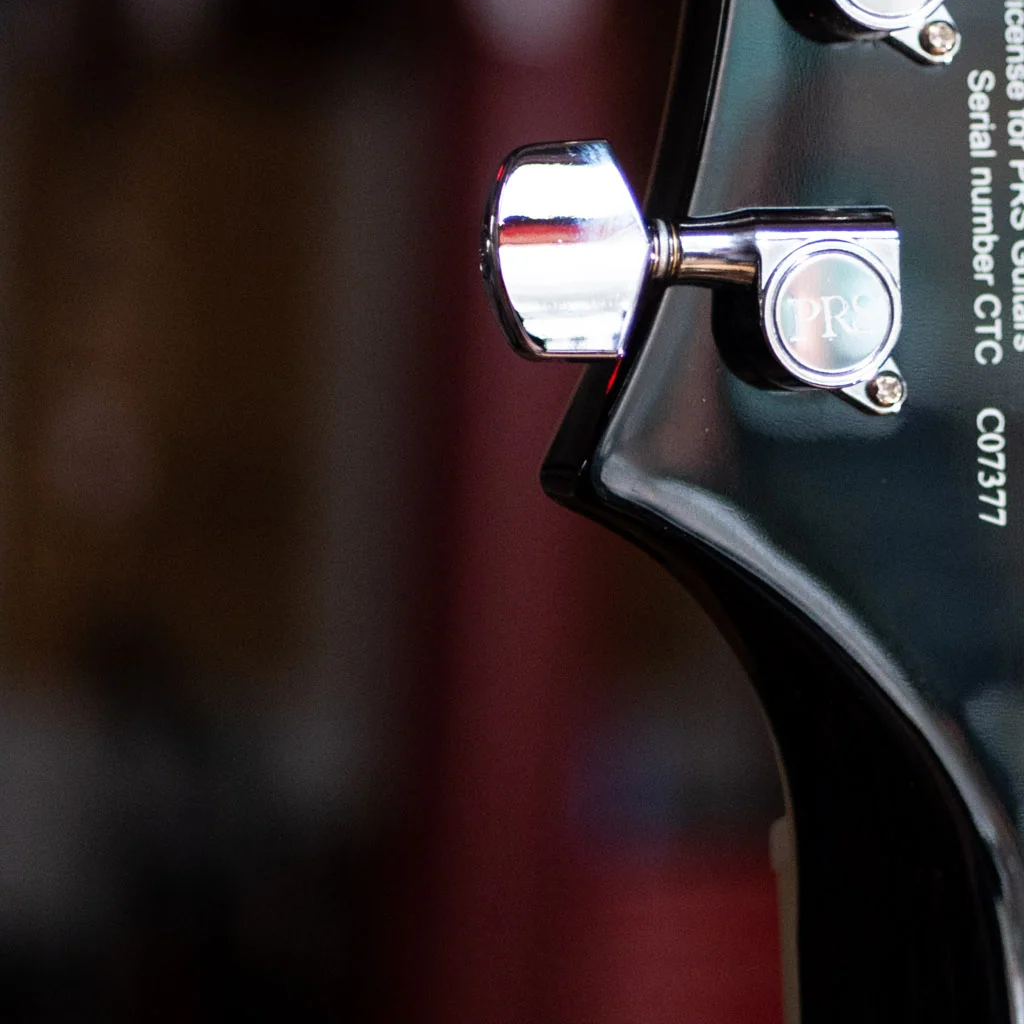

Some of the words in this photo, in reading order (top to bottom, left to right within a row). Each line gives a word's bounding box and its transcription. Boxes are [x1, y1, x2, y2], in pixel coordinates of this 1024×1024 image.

[966, 69, 998, 159] Serial
[970, 167, 1000, 287] number
[973, 292, 1004, 366] CTC
[976, 407, 1008, 527] C07377
